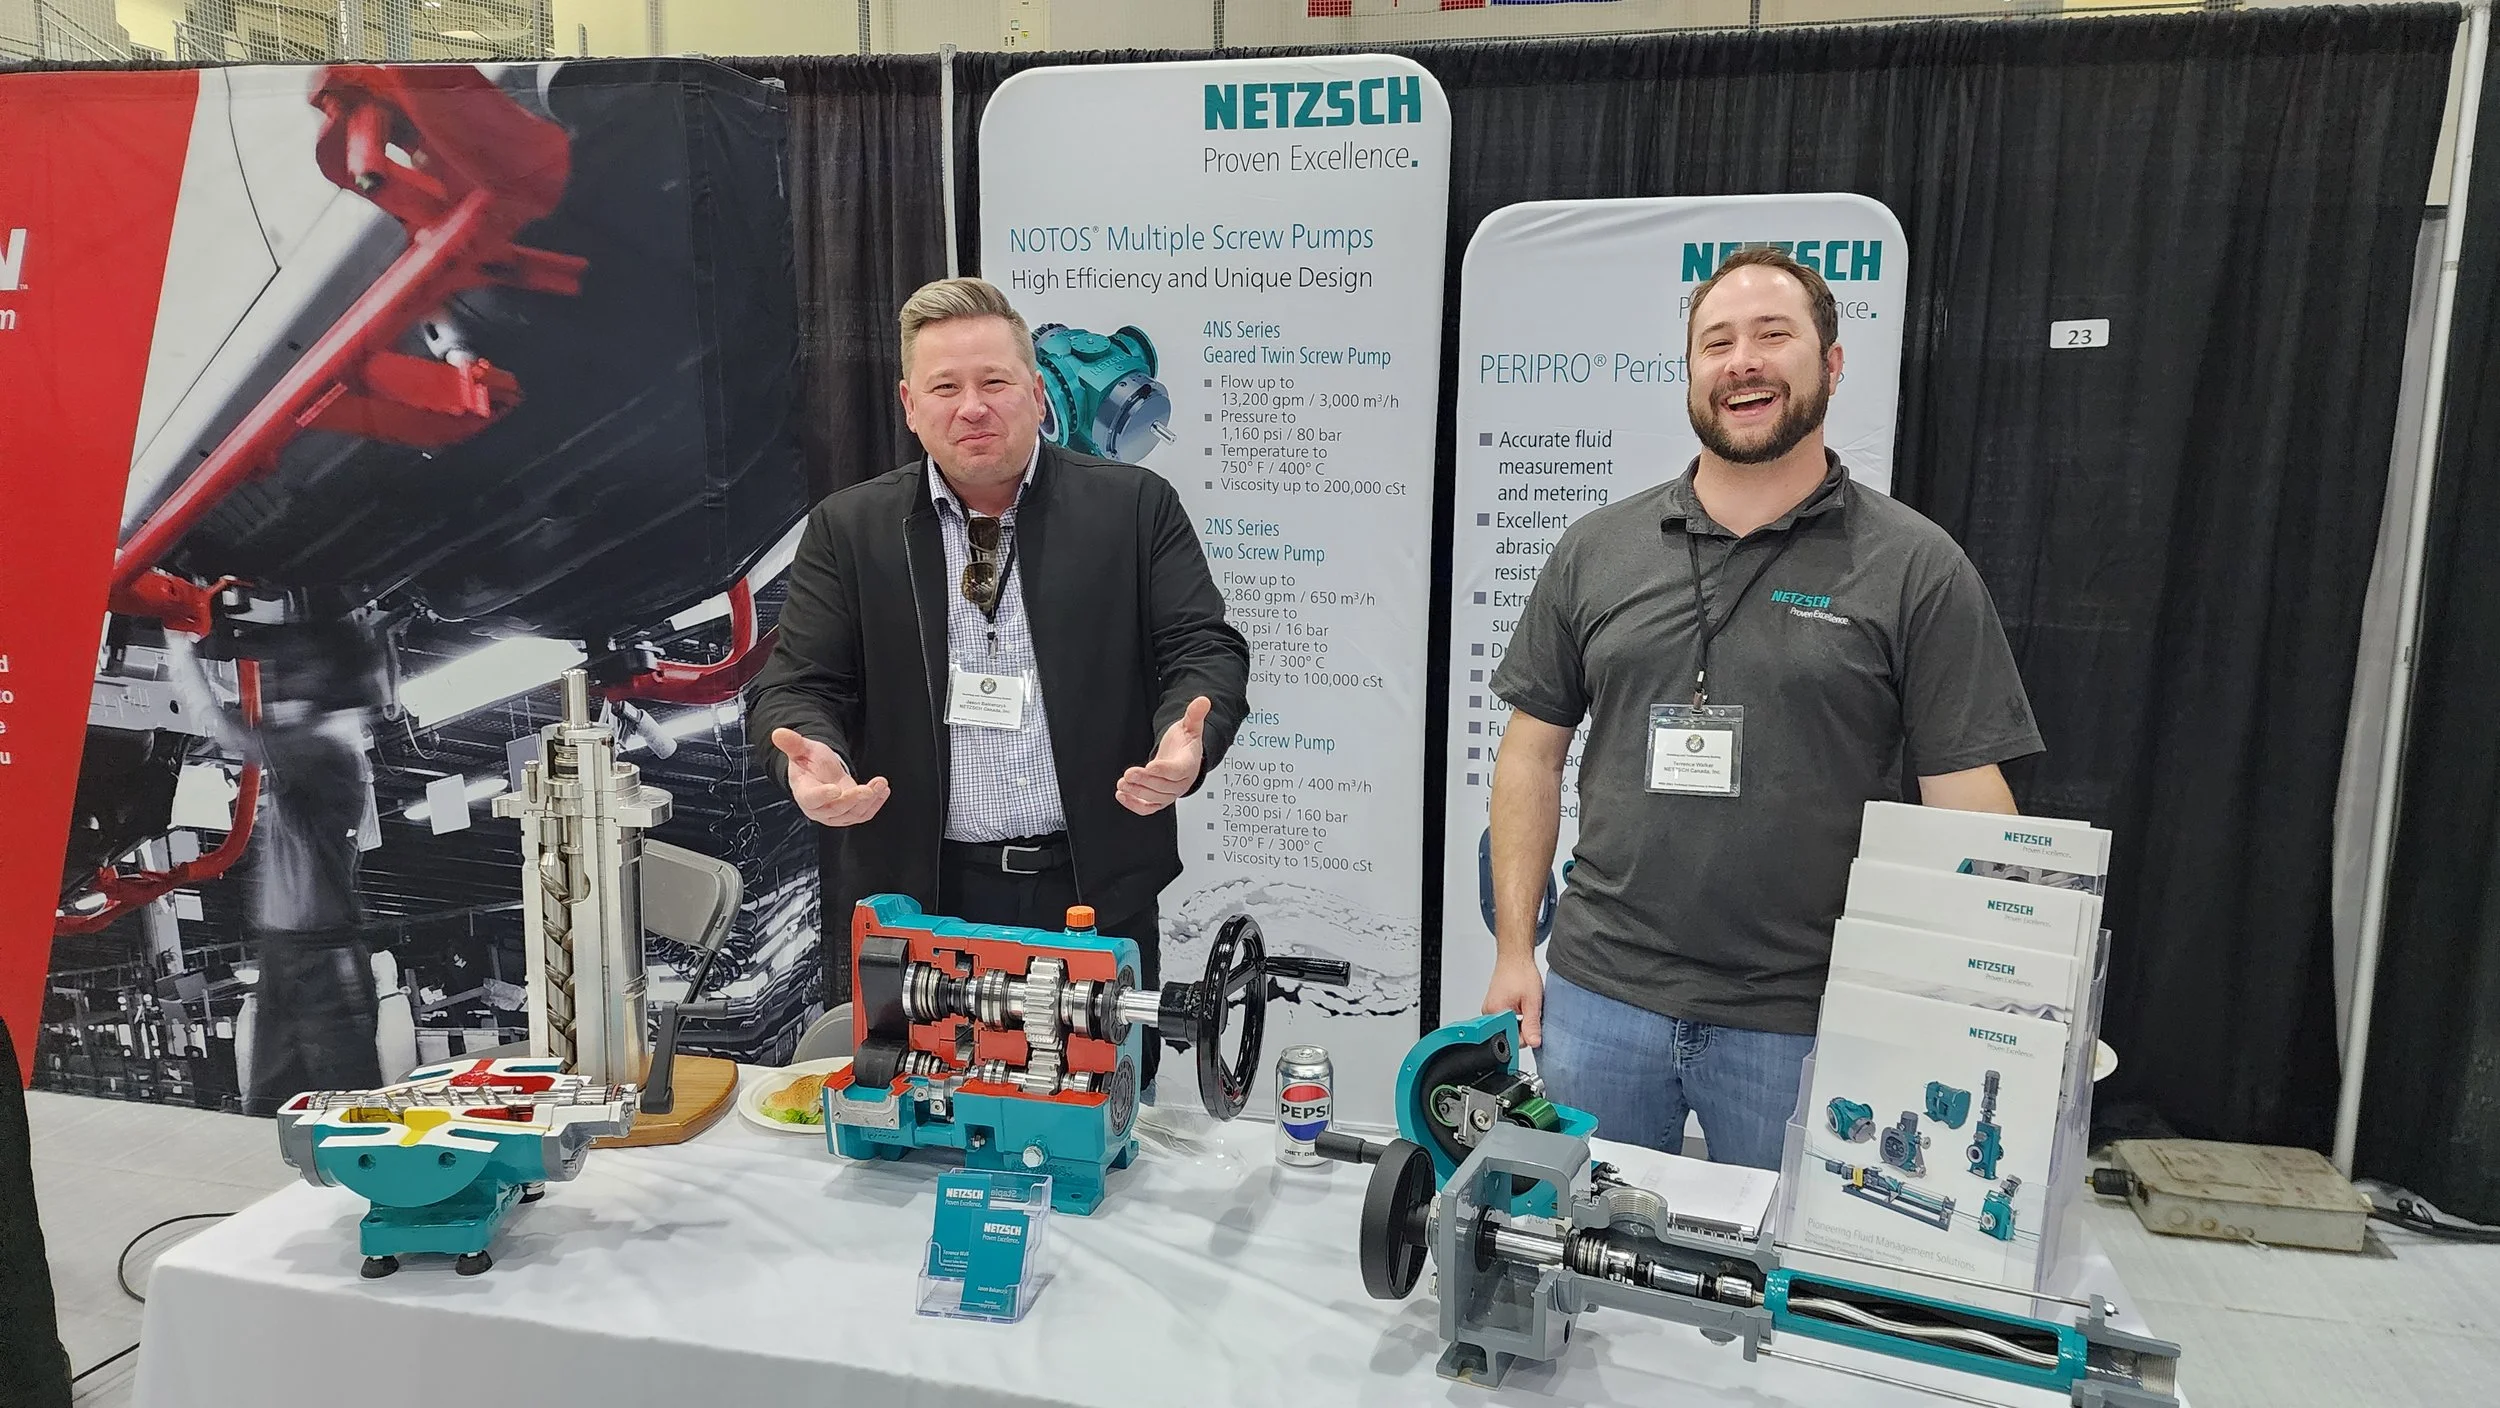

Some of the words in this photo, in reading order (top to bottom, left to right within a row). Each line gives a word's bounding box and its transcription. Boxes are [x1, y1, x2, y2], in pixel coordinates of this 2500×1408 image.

[1204, 76, 1421, 130] NETZSCH
[1204, 145, 1280, 173] Proven
[1291, 141, 1418, 171] Excellence.
[1108, 223, 1205, 257] Multiple
[1213, 224, 1284, 250] Screw
[1293, 224, 1373, 255] Pumps
[1012, 268, 1059, 295] High
[1066, 267, 1162, 294] Efficiency
[1168, 266, 1207, 288] and
[1215, 268, 1292, 293] Unique
[1299, 267, 1372, 293] Design
[1203, 321, 1232, 338] 4NS
[1237, 321, 1280, 338] Series
[2067, 329, 2092, 345] 23
[1204, 345, 1256, 363] Geared
[1261, 346, 1294, 363] Twin
[1300, 346, 1343, 364] Screw
[1348, 347, 1391, 369] Pump
[1221, 375, 1254, 389] Flow
[1258, 379, 1276, 391] up
[1280, 377, 1295, 389] to
[1222, 392, 1269, 407] 13,200
[1273, 395, 1304, 409] gpm
[1309, 394, 1316, 406] /
[1320, 393, 1359, 408] 3,000
[1221, 410, 1277, 423] Pressure
[1282, 412, 1296, 423] to
[1222, 427, 1259, 441] 1,160
[1264, 428, 1282, 443] psi
[1287, 428, 1293, 441] /
[1297, 428, 1314, 441] 80
[1319, 428, 1342, 441] bar
[1499, 430, 1571, 449] Accurate
[1575, 429, 1612, 448] fluid
[1221, 444, 1308, 460] Temperature
[1313, 447, 1327, 458] to
[1222, 461, 1253, 474] 750°
[1258, 461, 1264, 474] F
[1269, 462, 1275, 474] /
[1279, 462, 1311, 475] 400°
[1315, 463, 1324, 475] C
[1499, 459, 1613, 475] measurement
[1221, 478, 1280, 494] Viscosity
[1283, 482, 1301, 495] up
[1305, 481, 1319, 492] to
[1324, 480, 1381, 495] 200,000
[1385, 482, 1406, 496] cSt
[1498, 483, 1530, 501] and
[1533, 484, 1608, 506] metering
[1205, 518, 1233, 535] 2NS
[1238, 519, 1279, 536] Series
[1497, 511, 1568, 529] Excellent
[1205, 543, 1233, 559] Two
[1238, 543, 1279, 560] Screw
[1284, 544, 1325, 566] Pump
[1496, 538, 1555, 555] abrasio
[1223, 571, 1256, 586] Flow
[1259, 574, 1277, 588] up
[1281, 574, 1296, 586] to
[1224, 588, 1261, 602] 2,860
[1264, 591, 1295, 605] gpm
[1300, 591, 1306, 603] /
[1310, 591, 1336, 604] 650
[1770, 590, 1832, 608] NETZSCH
[1225, 604, 1279, 618] Pressure
[1283, 607, 1297, 619] to
[1790, 607, 1813, 618] Proven
[1253, 623, 1270, 636] psi
[1275, 623, 1281, 635] /
[1287, 623, 1302, 636] 16
[1306, 623, 1329, 636] bar
[1248, 640, 1310, 653] perature
[1314, 642, 1328, 653] to
[1258, 654, 1266, 666] F
[1270, 655, 1276, 666] /
[1280, 655, 1312, 668] 300°
[1315, 657, 1325, 669] C
[1249, 671, 1281, 686] osity
[1285, 673, 1299, 684] to
[1304, 673, 1359, 687] 100,000
[1363, 675, 1383, 688] cSt
[1243, 708, 1280, 725] eries
[1249, 731, 1290, 749] Screw
[1295, 733, 1336, 755] Pump
[1223, 757, 1256, 772] Flow
[1259, 762, 1276, 774] up
[1280, 761, 1294, 773] to
[1224, 774, 1260, 788] 1,760
[1263, 778, 1293, 790] gpm
[1298, 778, 1304, 789] /
[1308, 778, 1334, 791] 400
[1224, 789, 1279, 803] Pressure
[1283, 791, 1296, 804] to
[1223, 804, 1259, 818] 2,300
[1264, 808, 1281, 821] psi
[1286, 809, 1292, 820] /
[1297, 809, 1322, 821] 160
[1326, 810, 1348, 823] bar
[1224, 820, 1309, 836] Temperature
[1313, 825, 1326, 837] to
[1223, 835, 1253, 848] 570°
[1258, 837, 1265, 848] F
[1269, 839, 1274, 849] /
[1279, 839, 1309, 852] 300°
[1314, 841, 1323, 853] C
[2004, 831, 2053, 847] NETZSCH
[2022, 845, 2041, 854] Proven
[1223, 851, 1280, 868] Viscosity
[1284, 855, 1299, 867] to
[1303, 856, 1349, 871] 15,000
[1353, 858, 1372, 872] cSt
[1987, 900, 2034, 916] NETZSCH
[2004, 914, 2023, 923] Proven
[1968, 958, 2016, 976] NETZSCH
[1985, 973, 2005, 982] Proven
[1969, 1027, 2018, 1046] NETZSCH
[1987, 1043, 2006, 1052] Proven
[1281, 1102, 1330, 1119] PEPSI
[946, 1187, 984, 1199] NETZSCH
[982, 1233, 997, 1242] Proven
[983, 1222, 1022, 1236] NETZSCH
[1808, 1217, 1852, 1239] Pioneering
[1854, 1229, 1874, 1244] Fluid
[1876, 1235, 1934, 1259] Management
[1935, 1252, 1976, 1272] Solutions
